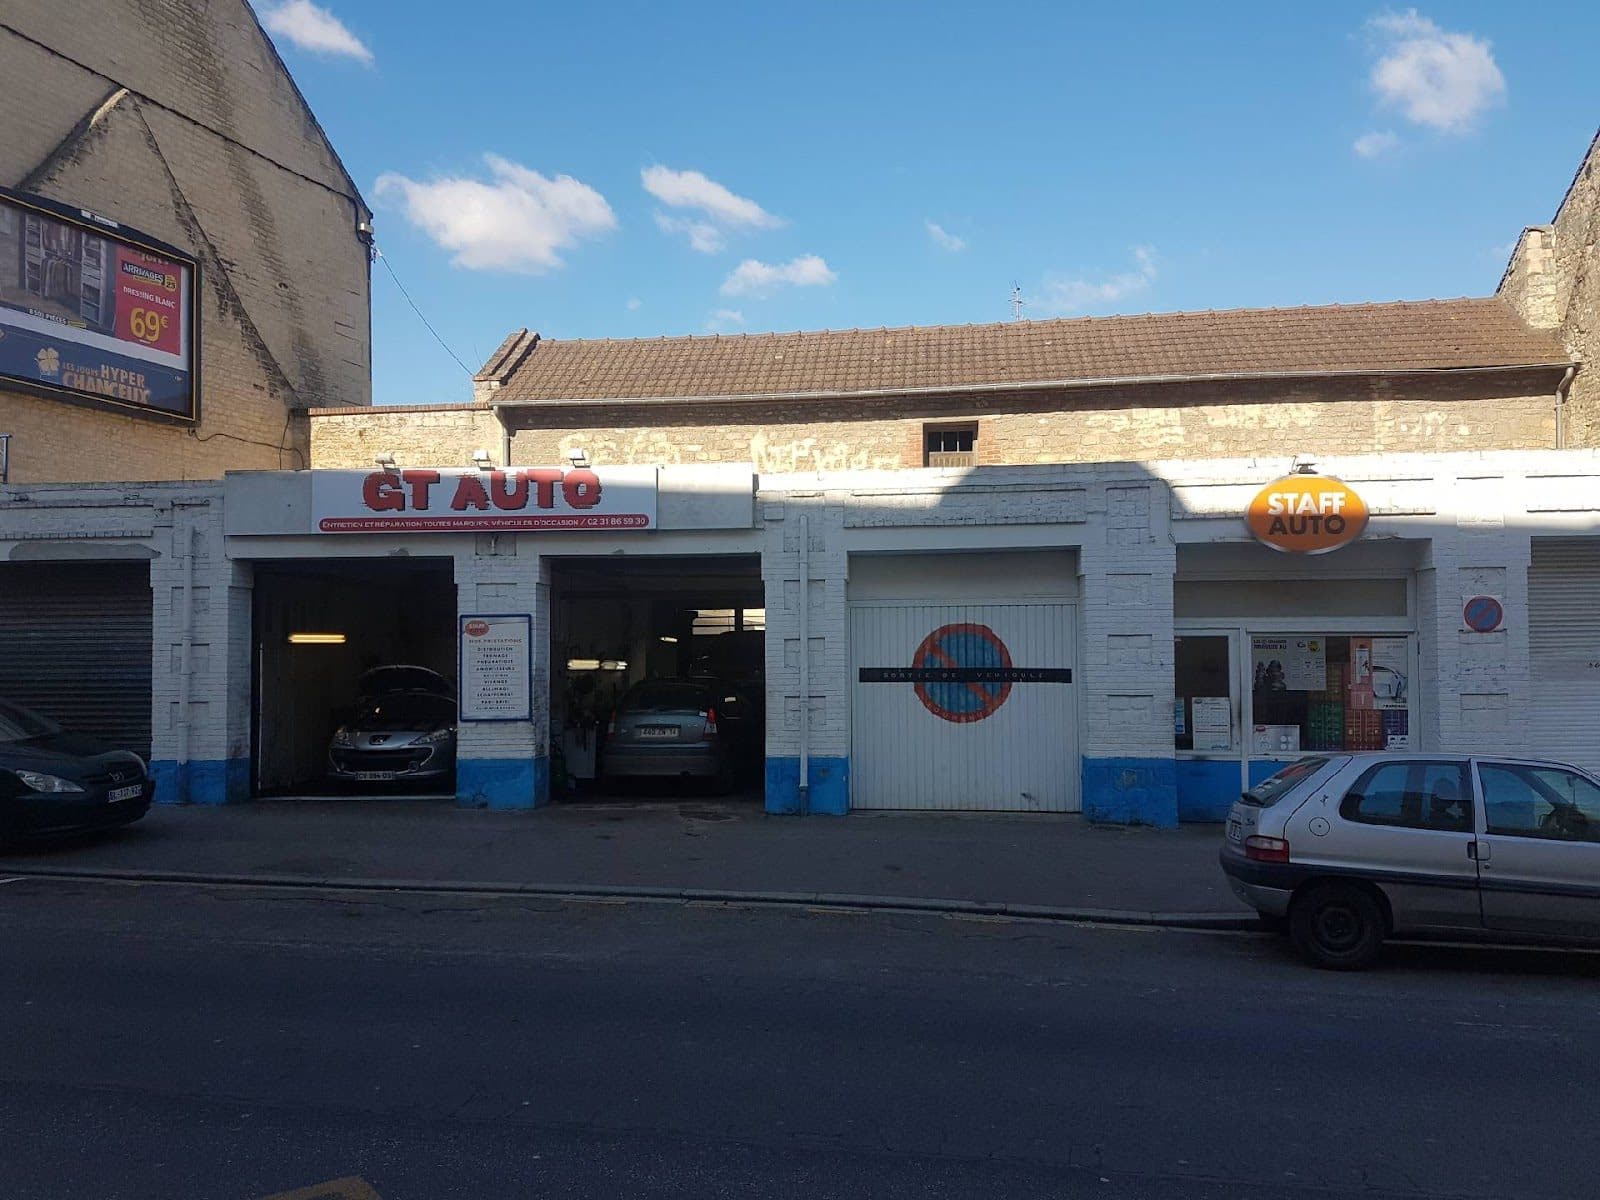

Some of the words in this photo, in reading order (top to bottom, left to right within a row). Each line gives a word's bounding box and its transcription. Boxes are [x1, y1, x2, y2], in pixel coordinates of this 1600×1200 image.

[122, 261, 165, 284] ARRIVAGES
[123, 286, 155, 302] DRESSING
[100, 364, 145, 388] HYPER
[62, 371, 151, 405] CHANCEUX
[363, 469, 441, 511] GT
[450, 469, 602, 511] AUTO
[1267, 491, 1346, 515] STAFF
[587, 517, 598, 526] 02
[599, 517, 608, 526] 31
[634, 516, 646, 525] 30
[1269, 514, 1346, 535] AUTO
